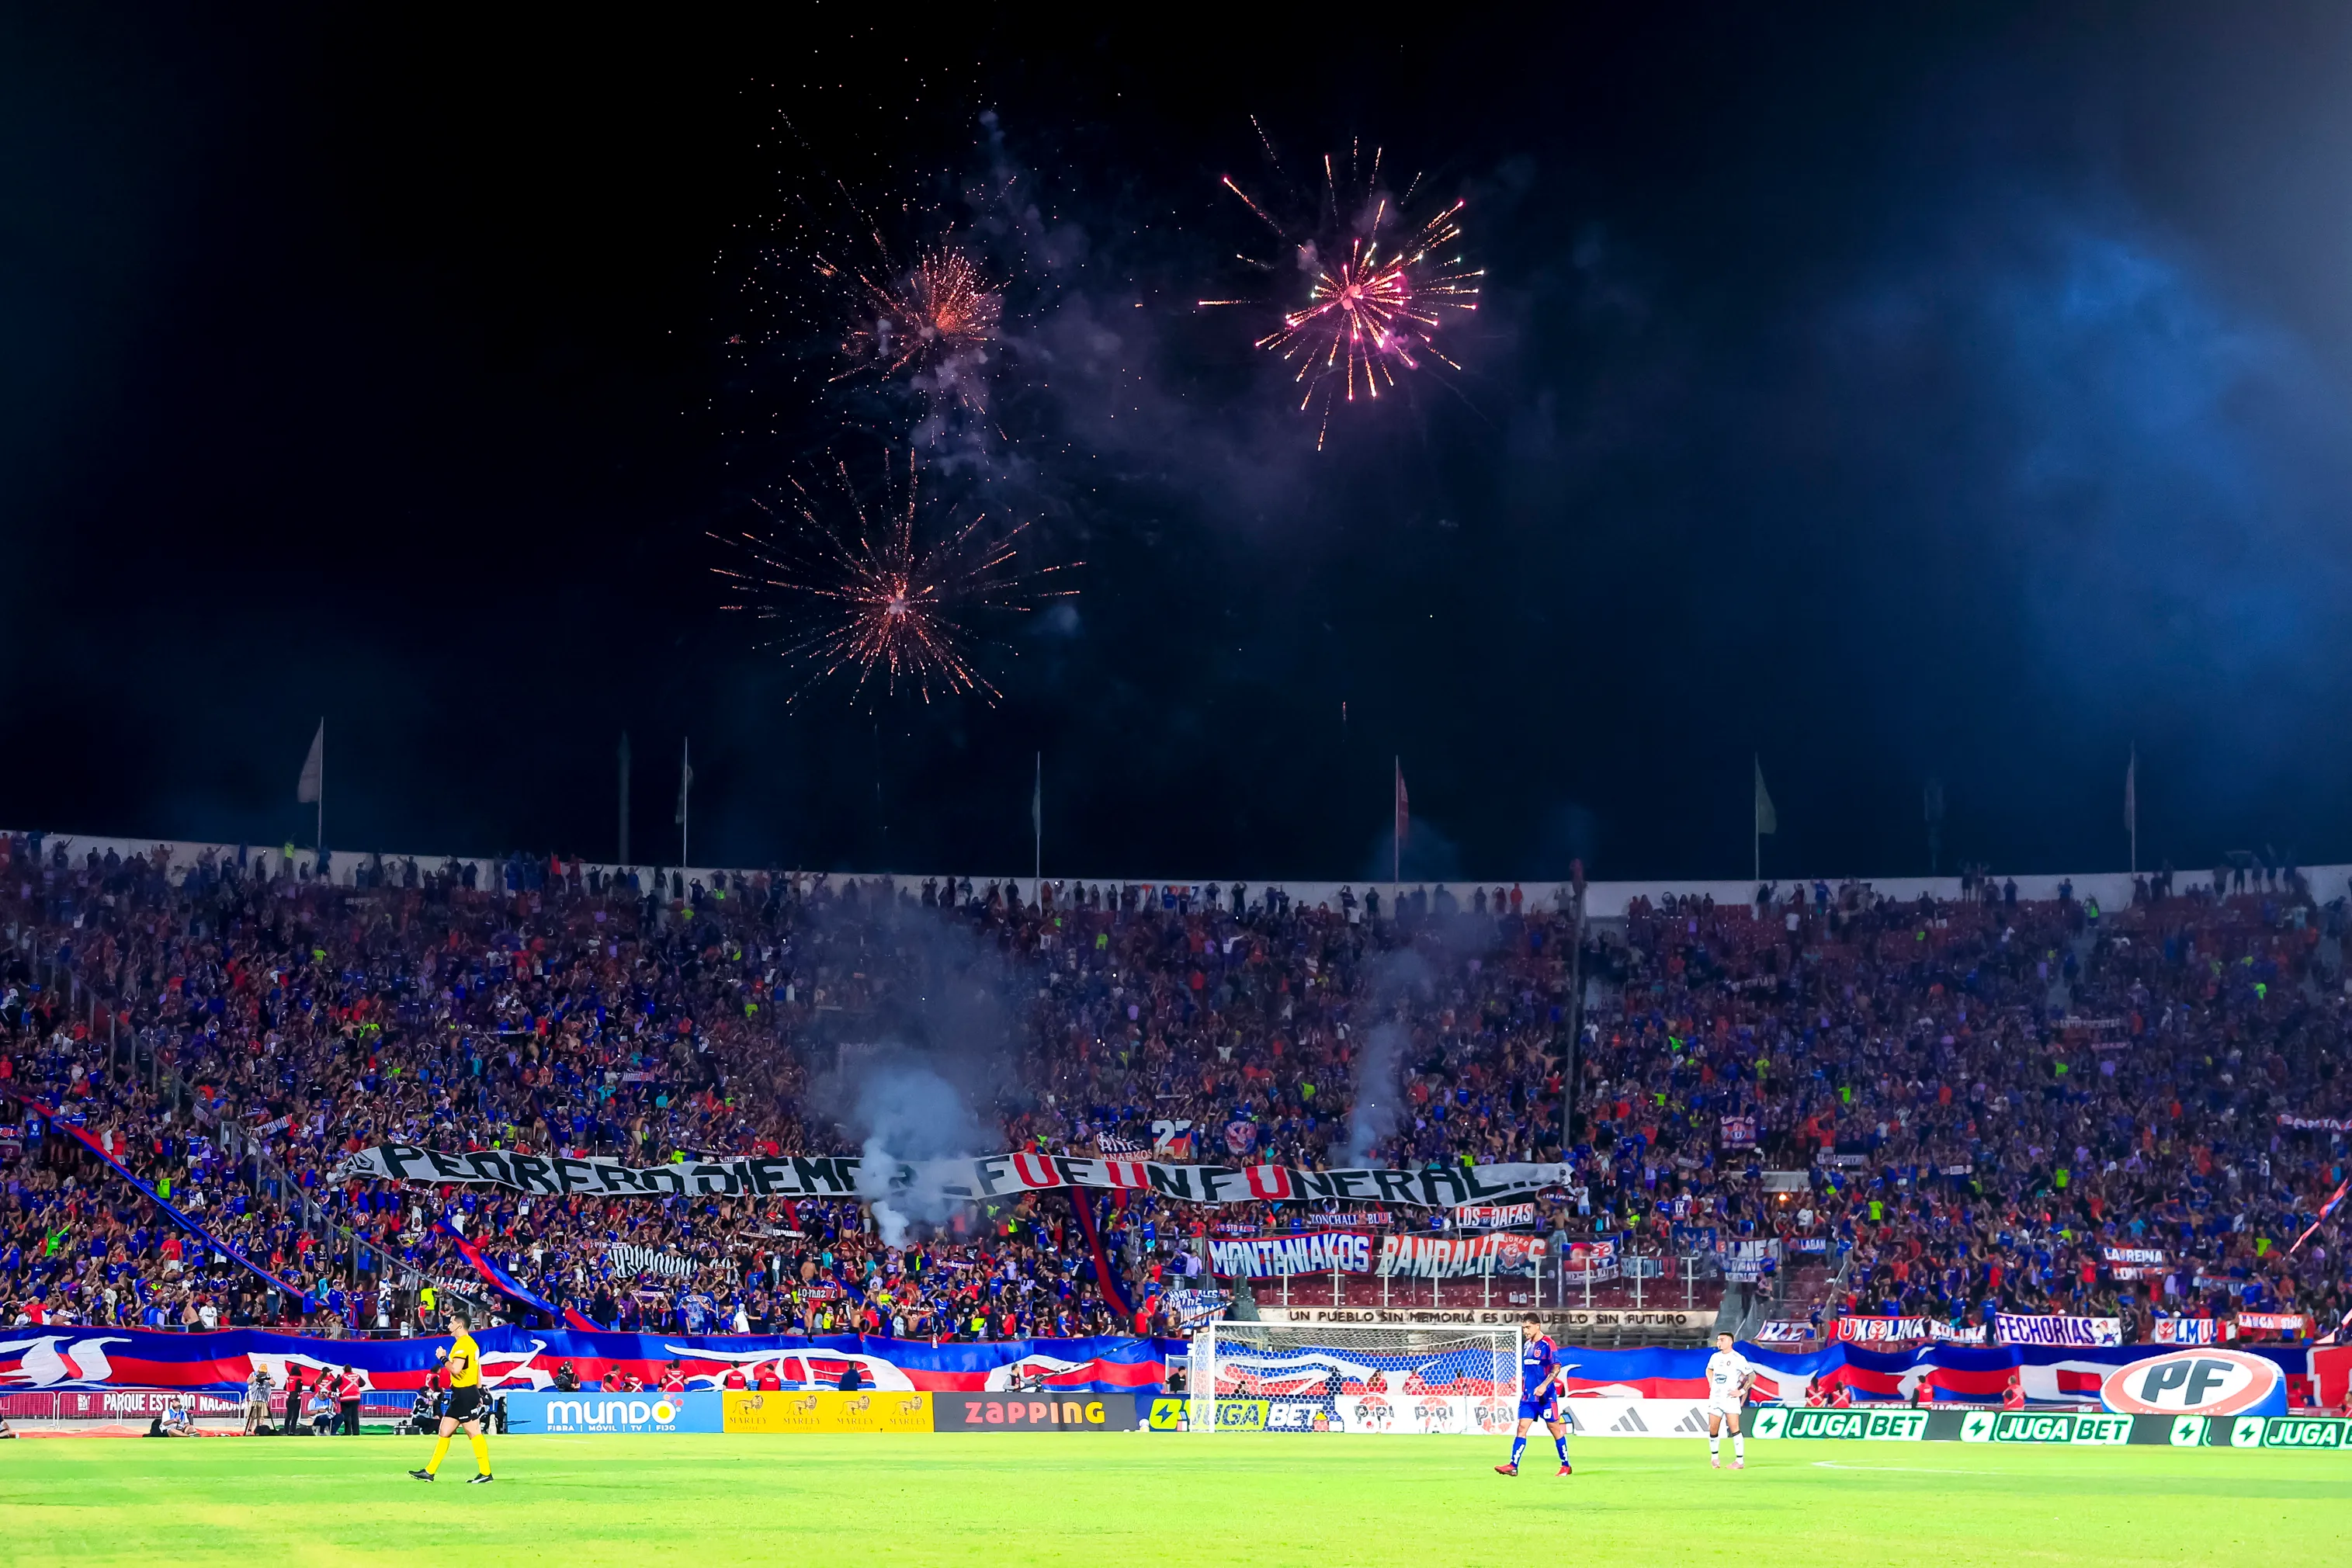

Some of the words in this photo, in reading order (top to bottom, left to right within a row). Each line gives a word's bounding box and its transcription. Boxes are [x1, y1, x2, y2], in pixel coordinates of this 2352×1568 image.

[1367, 1212, 1394, 1224] BLUE
[1456, 1206, 1480, 1227] LOS
[1375, 1233, 1545, 1278] BANDALITS
[2126, 1248, 2163, 1263] REINA
[1289, 1311, 1310, 1321] UN
[1320, 1311, 1375, 1322] PUEBLO
[1381, 1312, 1403, 1322] SIN
[1483, 1313, 1498, 1323] ES
[1541, 1313, 1588, 1324] UEBLO
[1596, 1313, 1618, 1323] SIN
[1628, 1313, 1687, 1324] FUTURO
[1997, 1316, 2096, 1344] FECHORIAS
[2141, 1360, 2235, 1405] PF
[104, 1393, 146, 1413] PARQUE
[149, 1393, 196, 1411] ESTIO
[1191, 1402, 1259, 1426] JUGA
[1268, 1403, 1324, 1427] BET
[588, 1423, 617, 1431] MÓVIL
[1792, 1414, 1862, 1437] JUGA
[1870, 1416, 1923, 1436] BET
[2000, 1417, 2069, 1440] JUGA
[2076, 1419, 2128, 1441] BET
[2270, 1422, 2337, 1445] JUGA
